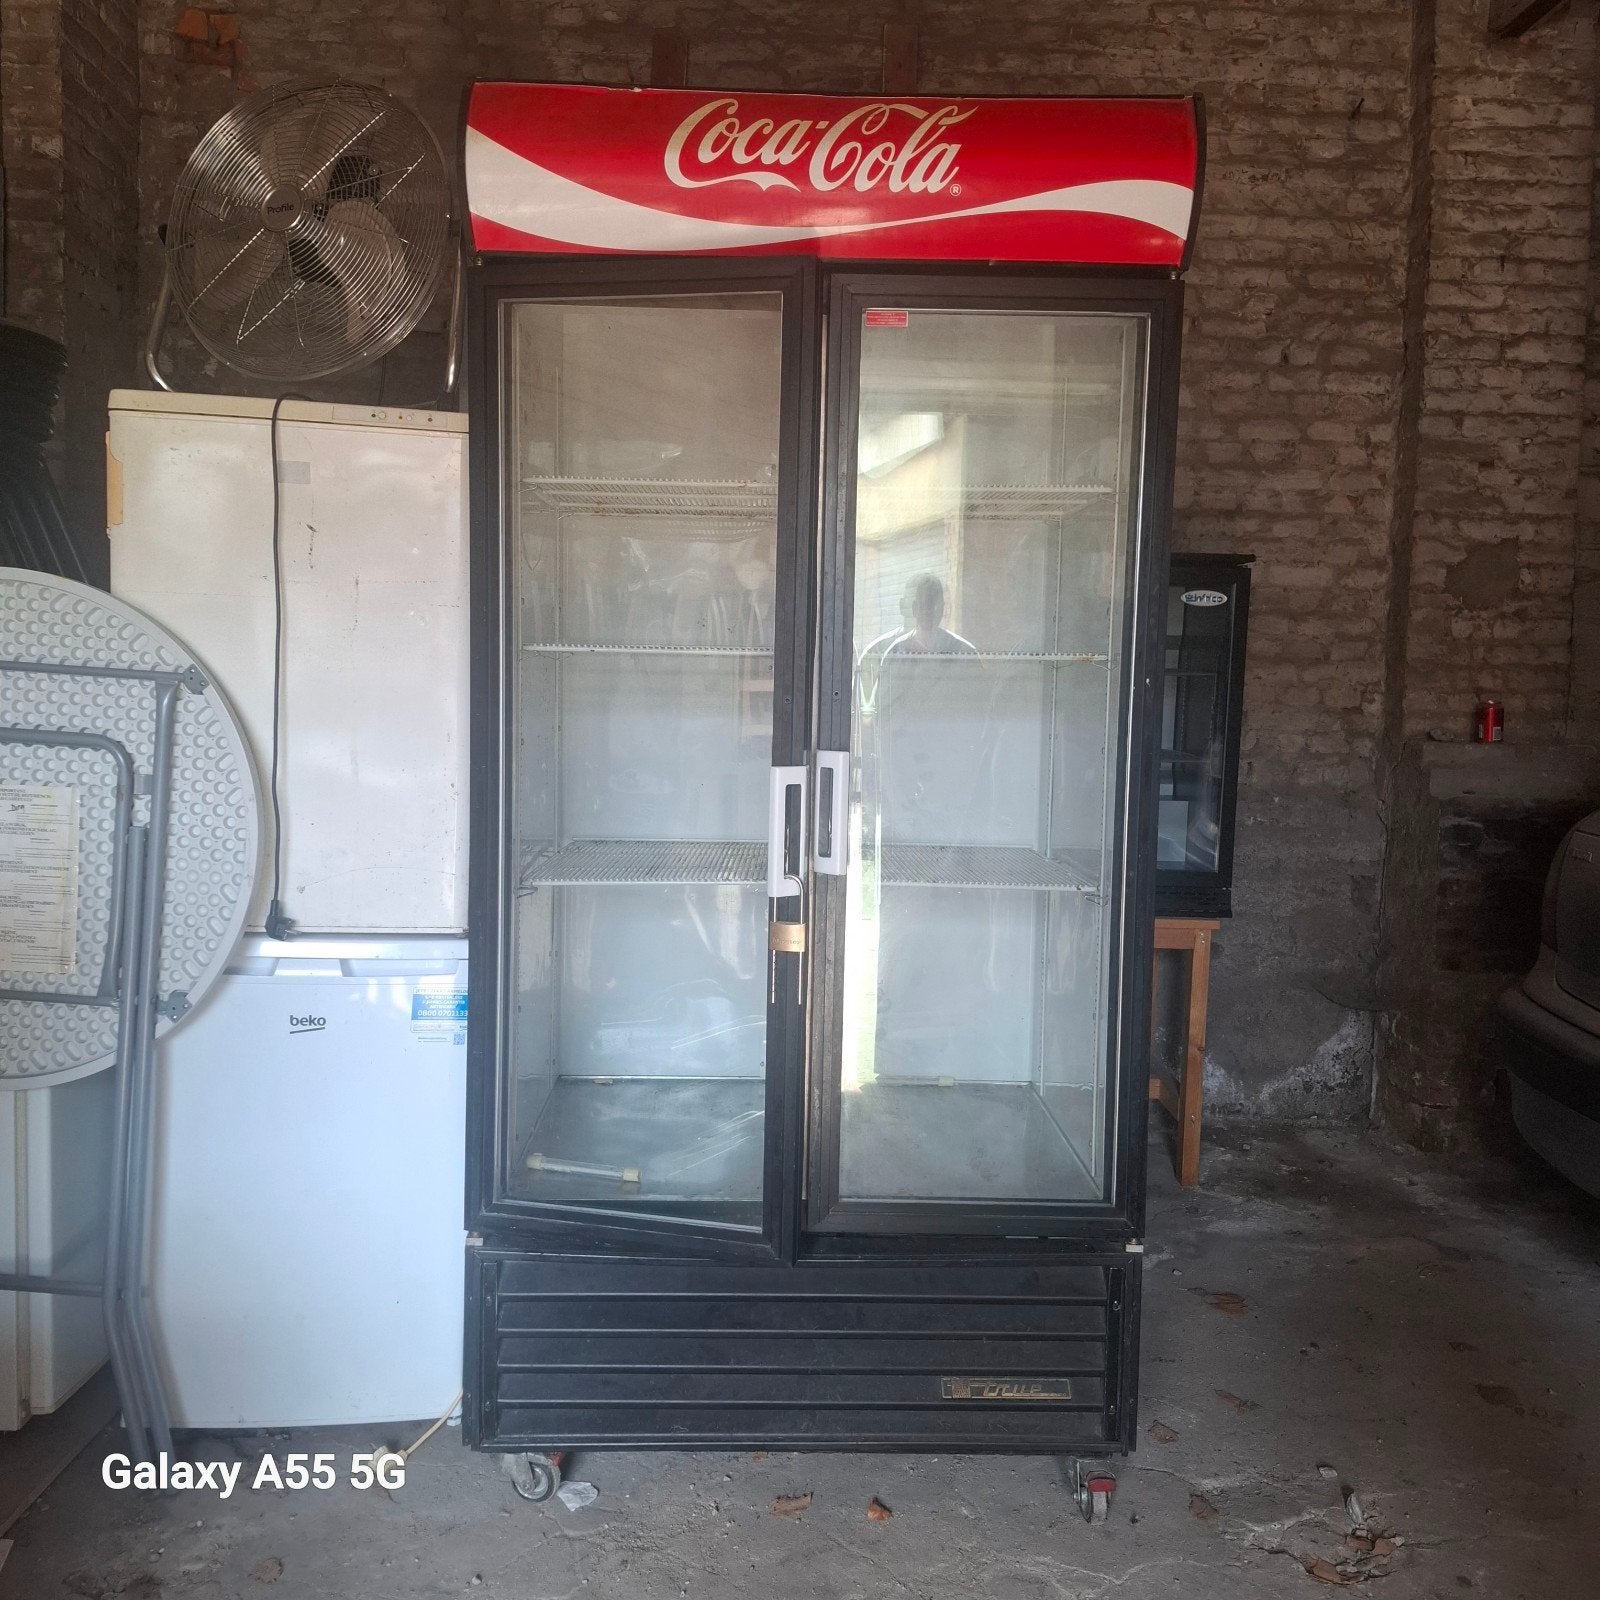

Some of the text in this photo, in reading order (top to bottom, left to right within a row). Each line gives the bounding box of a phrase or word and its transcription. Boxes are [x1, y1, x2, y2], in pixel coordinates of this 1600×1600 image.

[664, 98, 979, 193] Coca-Cola
[267, 203, 294, 215] Profile
[290, 1014, 327, 1027] beko
